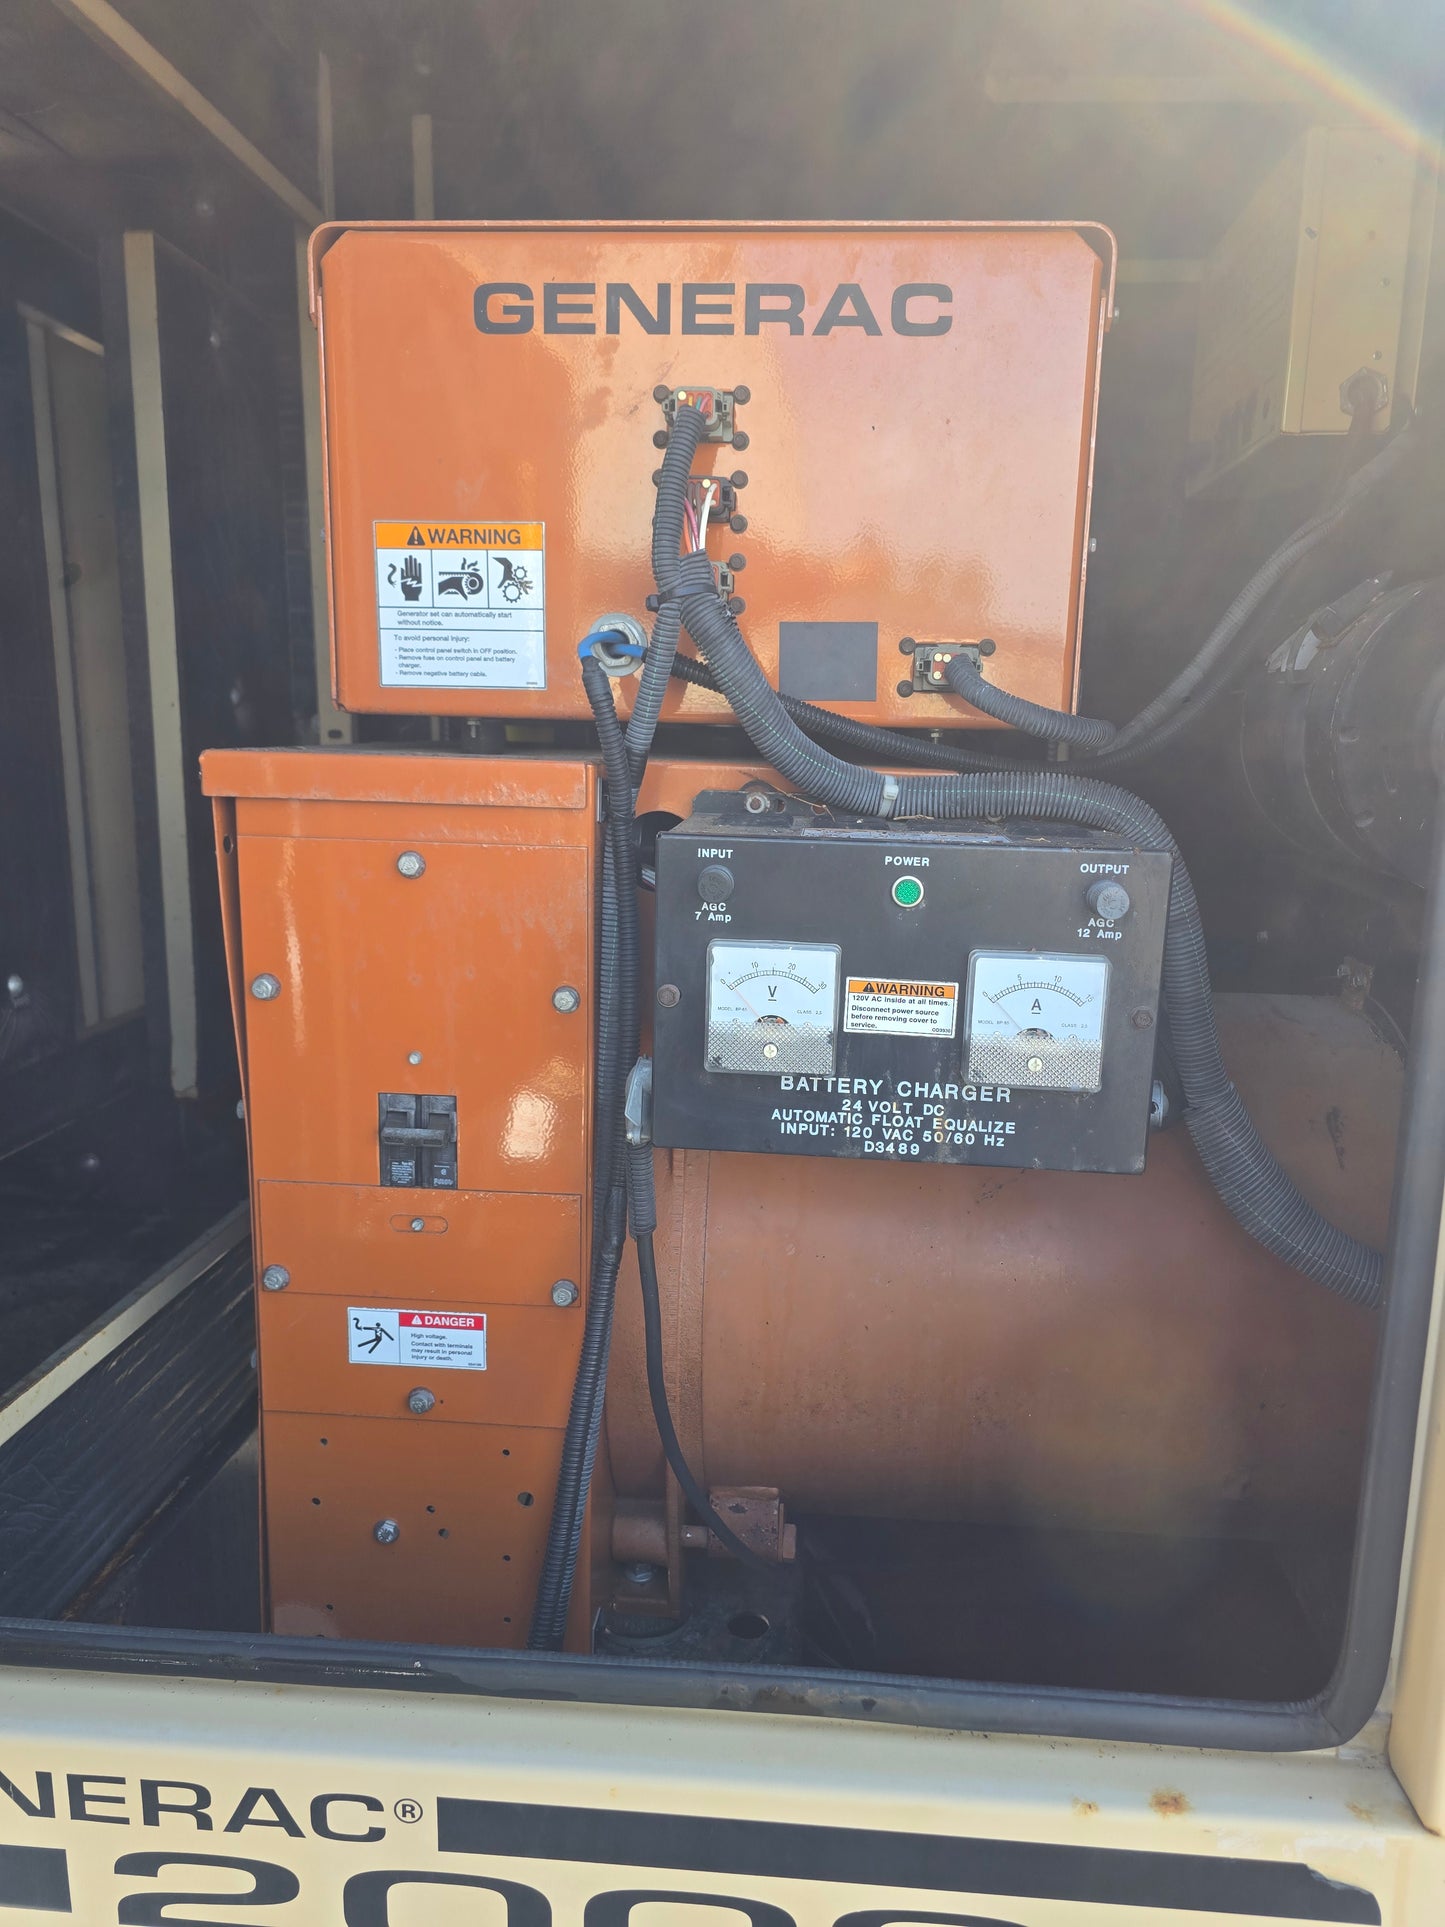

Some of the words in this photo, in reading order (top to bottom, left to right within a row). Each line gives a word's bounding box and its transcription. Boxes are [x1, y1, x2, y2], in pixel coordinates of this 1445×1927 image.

[473, 282, 954, 337] GENERAC
[428, 528, 521, 544] WARNING
[698, 848, 733, 858] INPUT
[885, 856, 930, 867] POWER
[1080, 864, 1129, 874] OUTPUT
[702, 902, 726, 911] AGC
[695, 912, 701, 920] 7
[708, 912, 731, 923] Amp
[1088, 918, 1114, 928] AGC
[1077, 928, 1090, 937] 12
[1097, 929, 1122, 940] Amp
[1055, 975, 1062, 983] 10
[768, 986, 777, 997] V
[876, 983, 944, 997] WARNING
[852, 1005, 890, 1013] Disconnect
[1031, 998, 1041, 1011] A
[875, 1015, 907, 1023] removing
[780, 1075, 883, 1095] BATTERY
[897, 1081, 1011, 1103] CHARGER
[842, 1099, 862, 1111] 24
[868, 1100, 912, 1114] VOLT
[923, 1104, 945, 1116] DC
[772, 1108, 863, 1125] AUTOMATIC
[871, 1115, 923, 1128] FLOAT
[933, 1117, 1016, 1134] EQUALIZE
[780, 1121, 835, 1137] INPUT:
[844, 1126, 872, 1139] 120
[882, 1128, 913, 1141] VAC
[923, 1131, 975, 1145] 50/60
[984, 1134, 1005, 1147] Hz
[864, 1140, 920, 1156] D3489
[425, 1316, 474, 1327] DANGER
[113, 1851, 1030, 1927] 200
